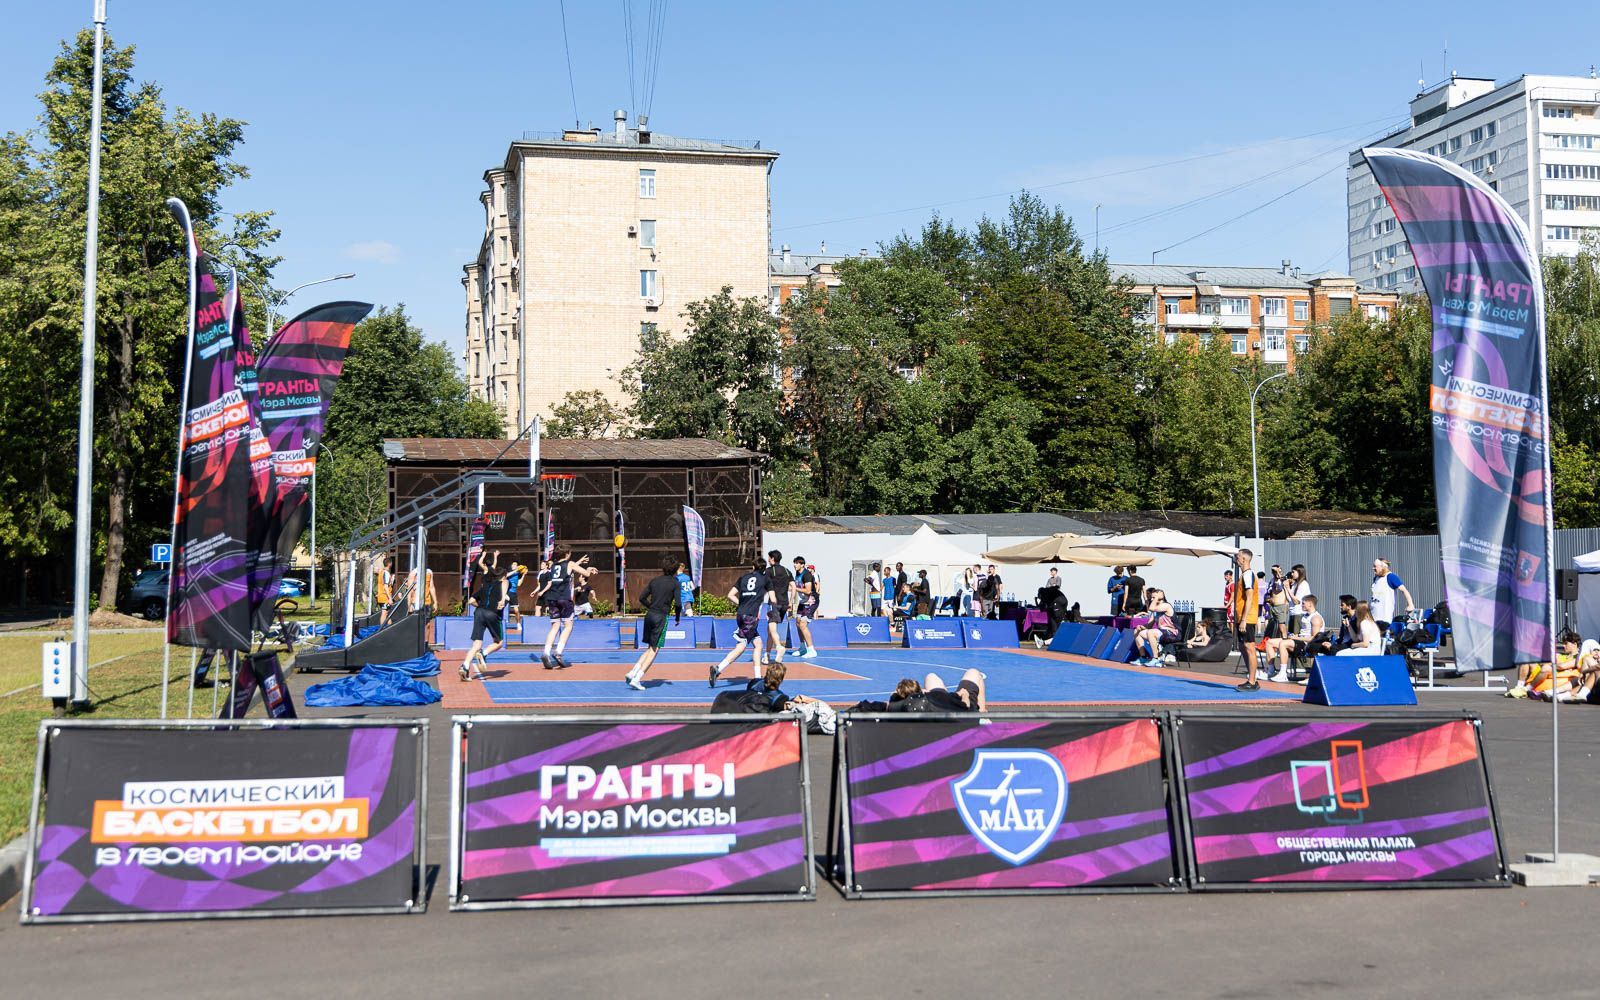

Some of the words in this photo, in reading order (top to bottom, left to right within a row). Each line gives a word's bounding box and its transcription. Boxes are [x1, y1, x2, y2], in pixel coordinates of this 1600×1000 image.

[258, 378, 319, 396] ГРАНТЫ
[157, 546, 169, 561] P
[553, 565, 562, 579] 3
[746, 576, 757, 591] 8
[539, 763, 736, 801] ГРАНТЫ
[130, 779, 336, 806] КОСМИЧЕСКИЙ
[102, 808, 360, 837] БАСКЕТБОЛ
[539, 805, 618, 833] Мэра
[625, 803, 737, 829] Москвы
[1276, 837, 1370, 850] ОБЩЕСТВЕННАЯ
[1371, 837, 1416, 849] ПАЛАТА
[1299, 851, 1346, 863] ГОРОДА
[1345, 850, 1397, 862] МОСКВЫ
